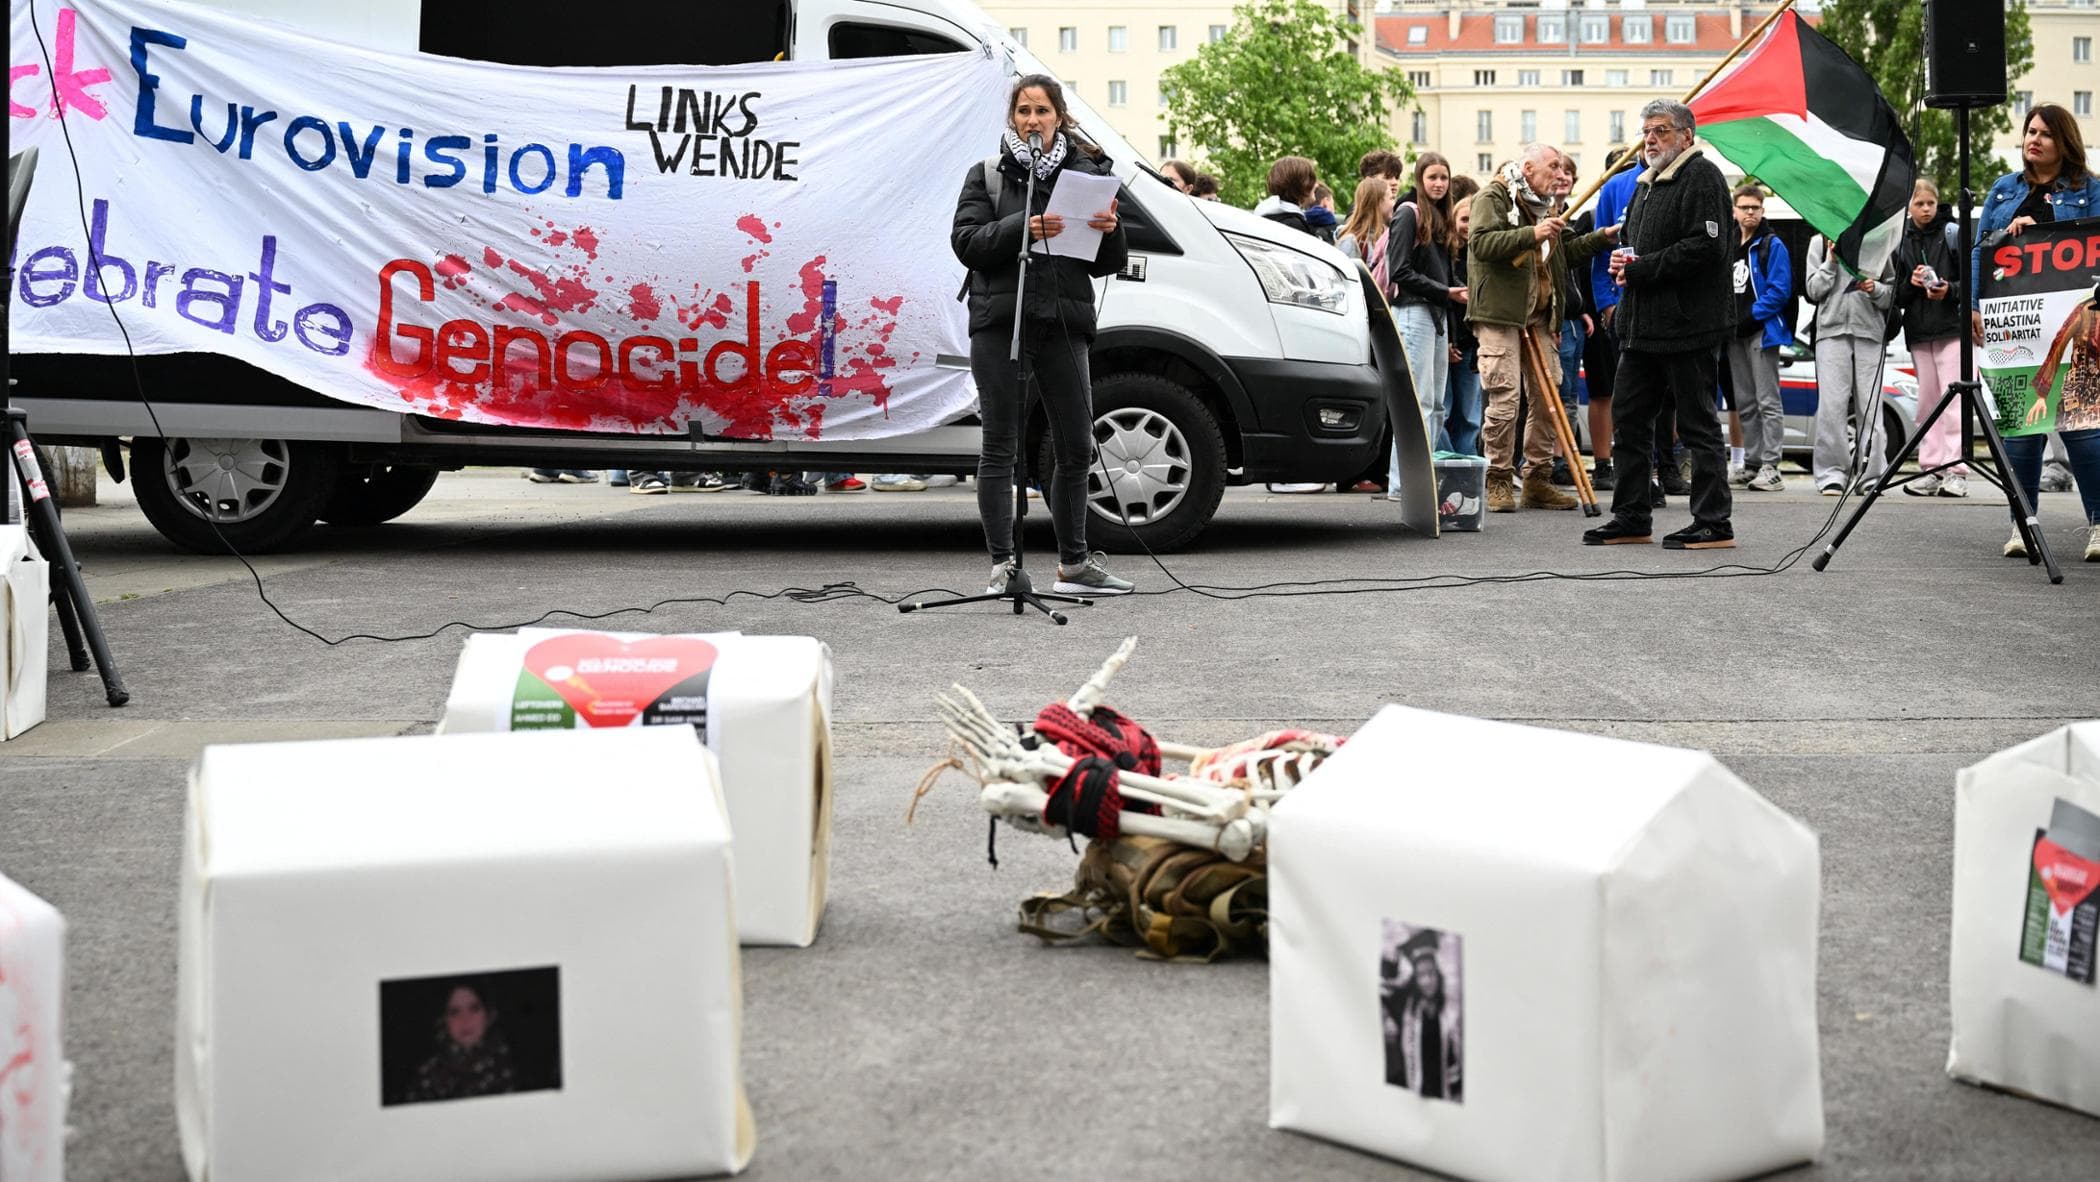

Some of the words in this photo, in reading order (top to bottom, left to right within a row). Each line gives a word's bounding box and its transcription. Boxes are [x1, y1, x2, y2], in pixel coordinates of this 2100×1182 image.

[129, 25, 625, 200] Eurovision
[625, 83, 762, 138] LINKS
[648, 131, 801, 182] WENDE
[10, 198, 354, 358] ebrate
[1984, 298, 2044, 314] INITIATIVE
